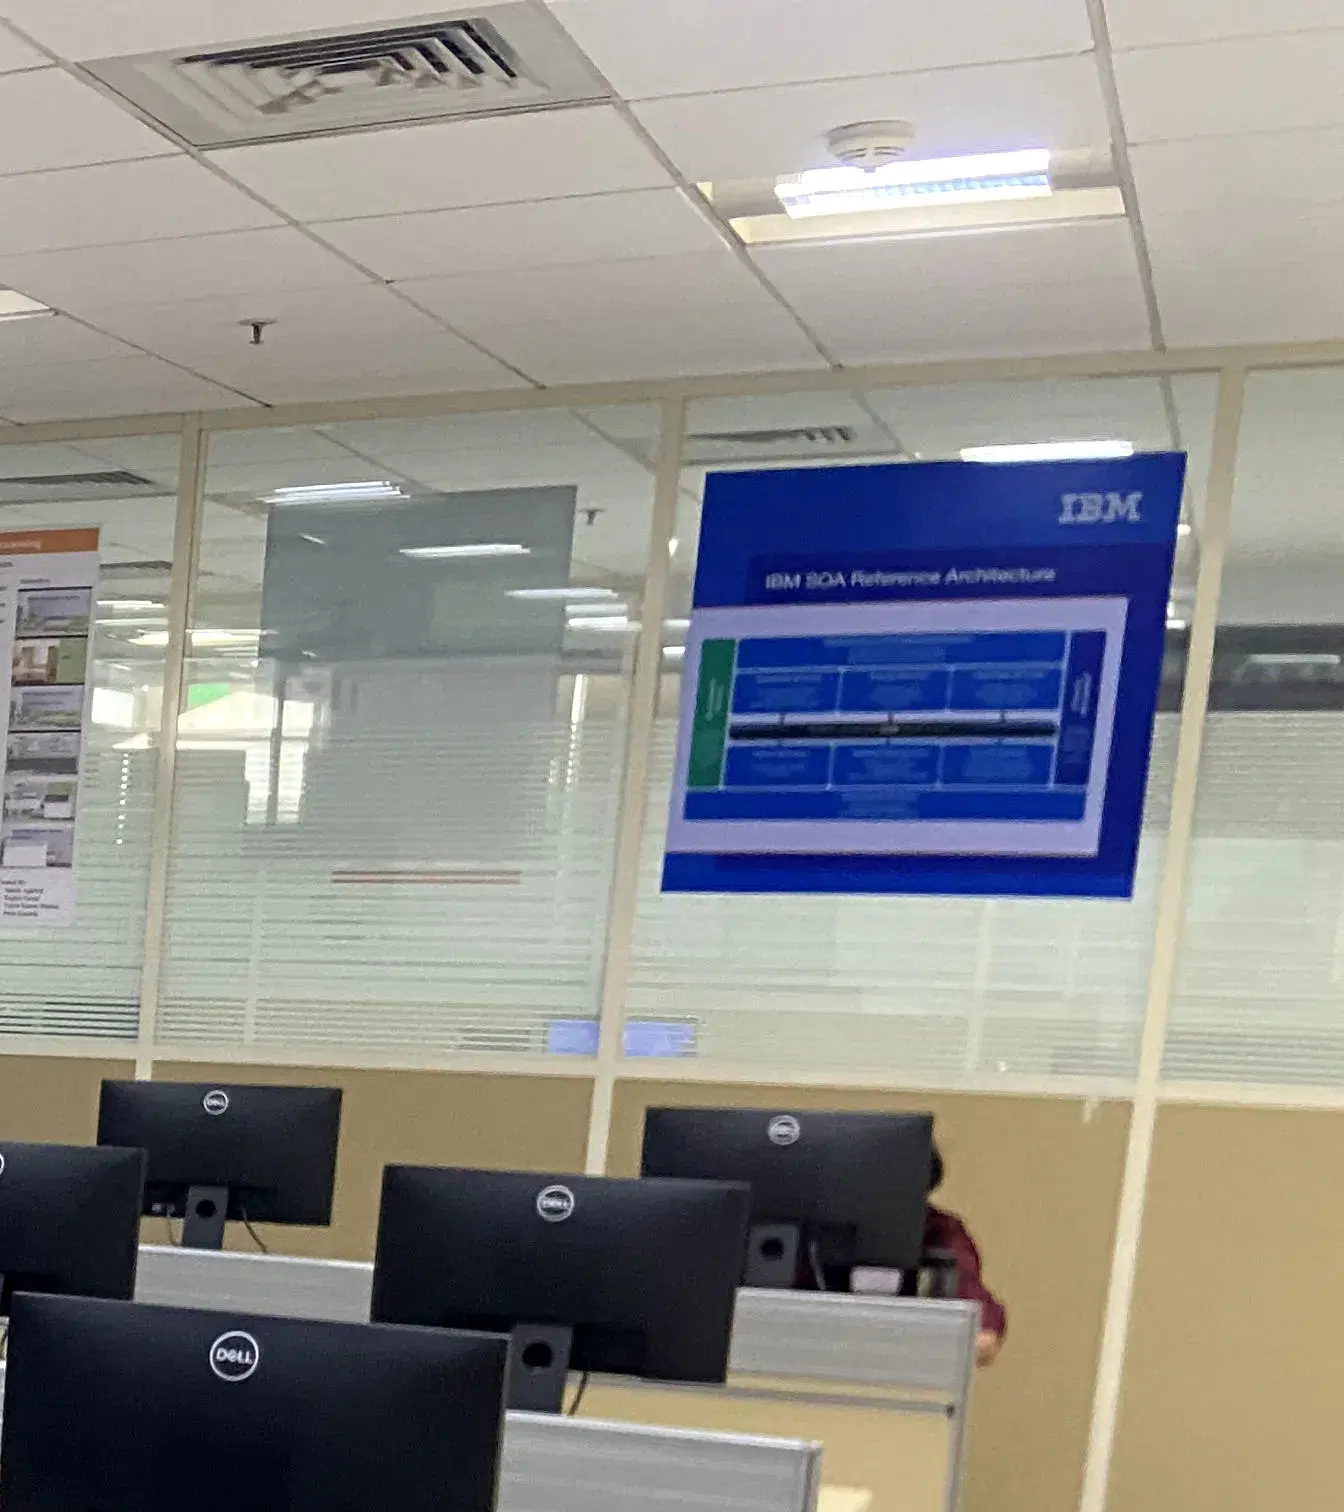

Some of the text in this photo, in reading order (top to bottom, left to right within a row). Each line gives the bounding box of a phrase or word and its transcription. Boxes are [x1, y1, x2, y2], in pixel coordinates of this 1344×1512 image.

[1058, 490, 1143, 525] IBM
[765, 567, 1057, 590] IBM SOA Reference Architecture
